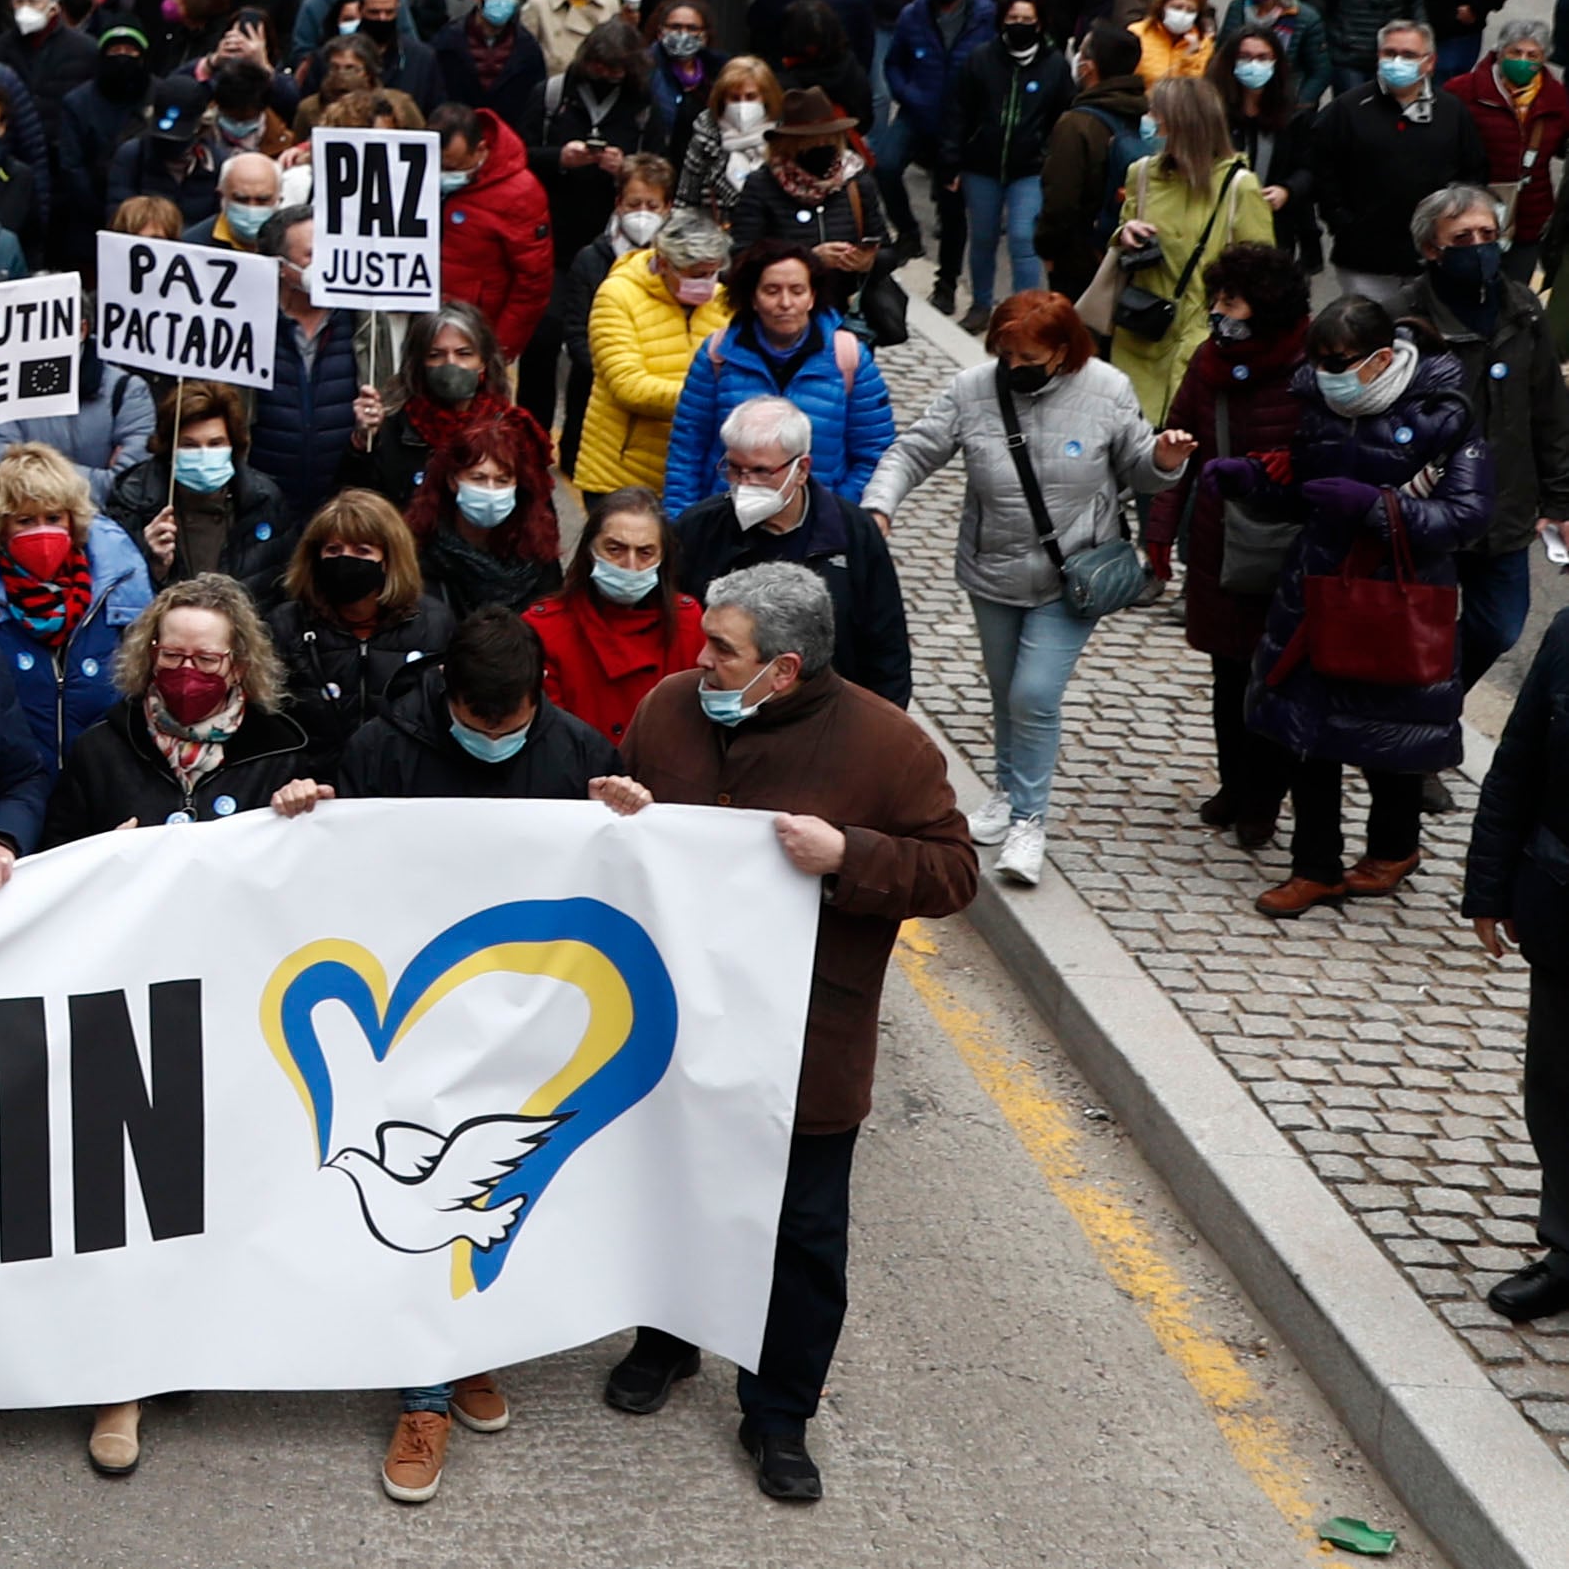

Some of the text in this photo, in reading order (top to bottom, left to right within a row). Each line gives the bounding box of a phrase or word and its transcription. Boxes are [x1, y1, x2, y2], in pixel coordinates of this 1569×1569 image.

[325, 142, 429, 239] PAZ
[129, 244, 239, 309] PAZ
[323, 247, 432, 289] JUSTA
[102, 302, 270, 380] PACTADA.
